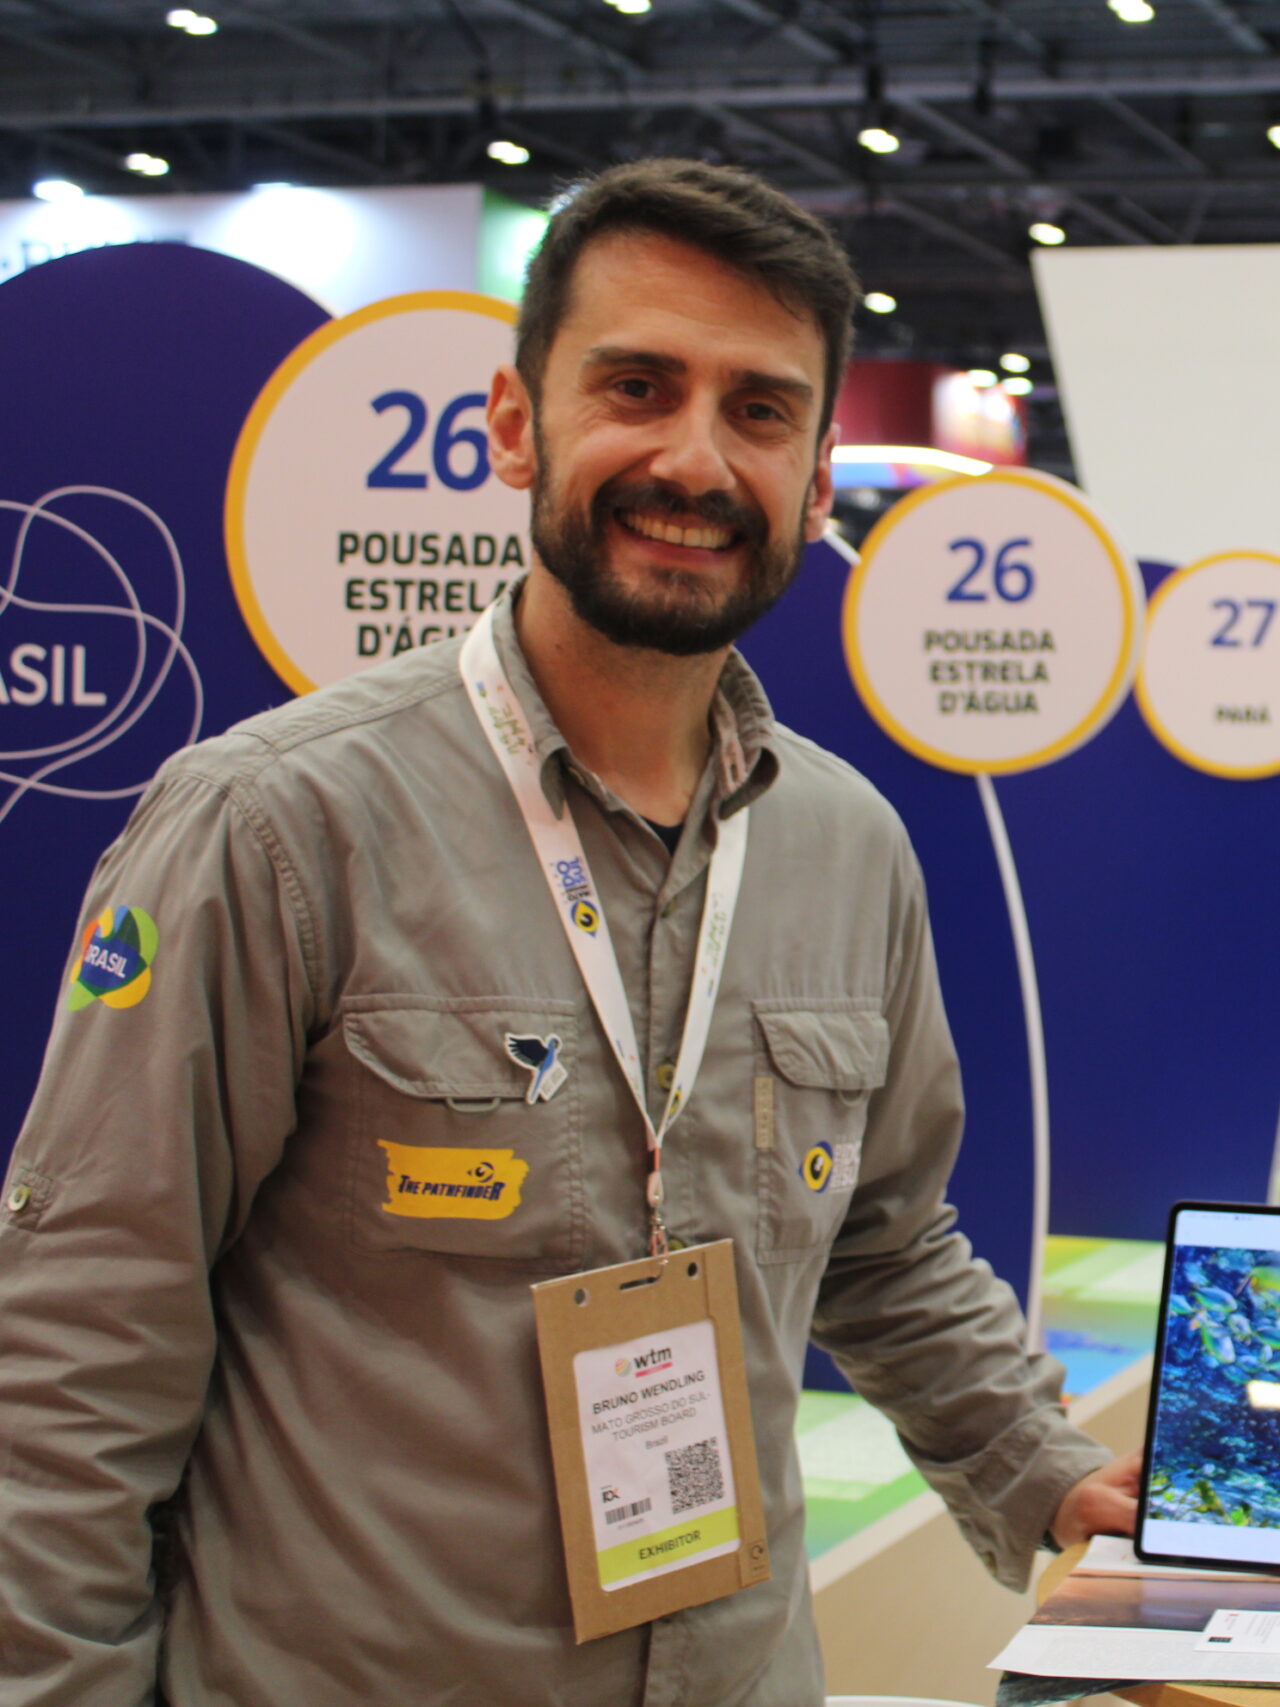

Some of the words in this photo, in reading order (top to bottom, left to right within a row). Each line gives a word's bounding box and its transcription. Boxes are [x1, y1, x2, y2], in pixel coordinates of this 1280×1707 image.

[366, 389, 492, 491] 26
[337, 531, 525, 567] POUSADA
[945, 536, 1035, 603] 26
[1211, 598, 1277, 648] 27
[924, 630, 1055, 652] POUSADA
[930, 660, 1049, 684] ESTRELA
[938, 690, 1040, 715] D'ÁGUA
[634, 1348, 672, 1369] wtm
[592, 1391, 639, 1414] BRUNO
[641, 1370, 705, 1399] WENDLING
[591, 1418, 623, 1434] MATO
[625, 1402, 670, 1425] GROSSO
[612, 1419, 658, 1441] TOURISM
[661, 1407, 696, 1426] BOARD
[639, 1530, 702, 1560] EXHIBITOR
